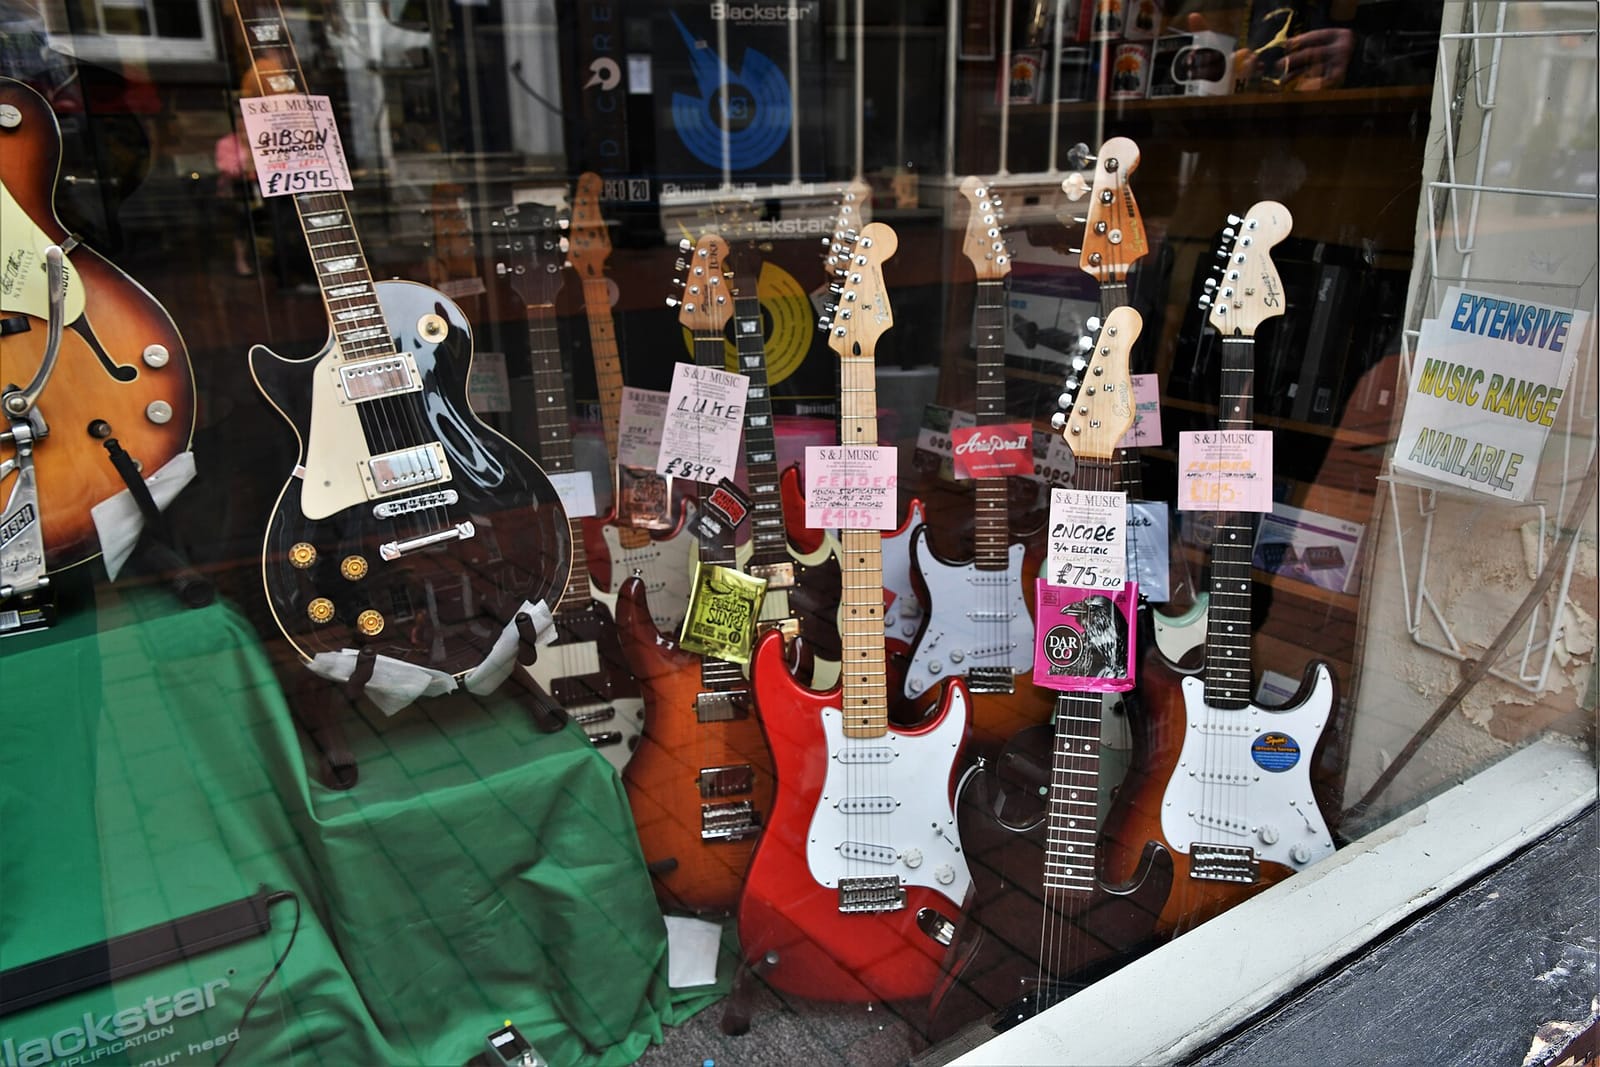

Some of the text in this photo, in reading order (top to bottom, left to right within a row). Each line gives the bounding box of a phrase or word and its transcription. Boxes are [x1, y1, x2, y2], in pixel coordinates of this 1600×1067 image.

[711, 4, 811, 20] Blackstar
[248, 103, 257, 115] S
[260, 102, 270, 113] &
[285, 100, 327, 112] MUSIC
[256, 128, 328, 149] GIBSON
[260, 144, 325, 156] STANDARD
[632, 182, 648, 200] 20
[1451, 293, 1573, 352] EXTENSIVE
[683, 367, 690, 378] S
[691, 369, 699, 380] &
[709, 373, 740, 388] MUSIC
[1417, 358, 1563, 427] MUSIC RANGE
[677, 395, 742, 420] LUKE
[1194, 433, 1255, 444] S & J MUSIC
[820, 450, 826, 460] S
[828, 449, 835, 460] &
[847, 449, 879, 461] MUSIC
[1409, 427, 1523, 491] AVAILABLE
[816, 475, 896, 489] FENDER
[1055, 492, 1120, 508] S & J MUSIC
[1052, 523, 1116, 541] ENCORE
[1053, 542, 1108, 555] 3/4 ELECTRIC
[1050, 635, 1078, 649] DAR
[1052, 648, 1072, 660] CO
[0, 977, 231, 1067] lackstar
[50, 1025, 174, 1067] MPLIFICATION
[188, 1028, 240, 1056] head
